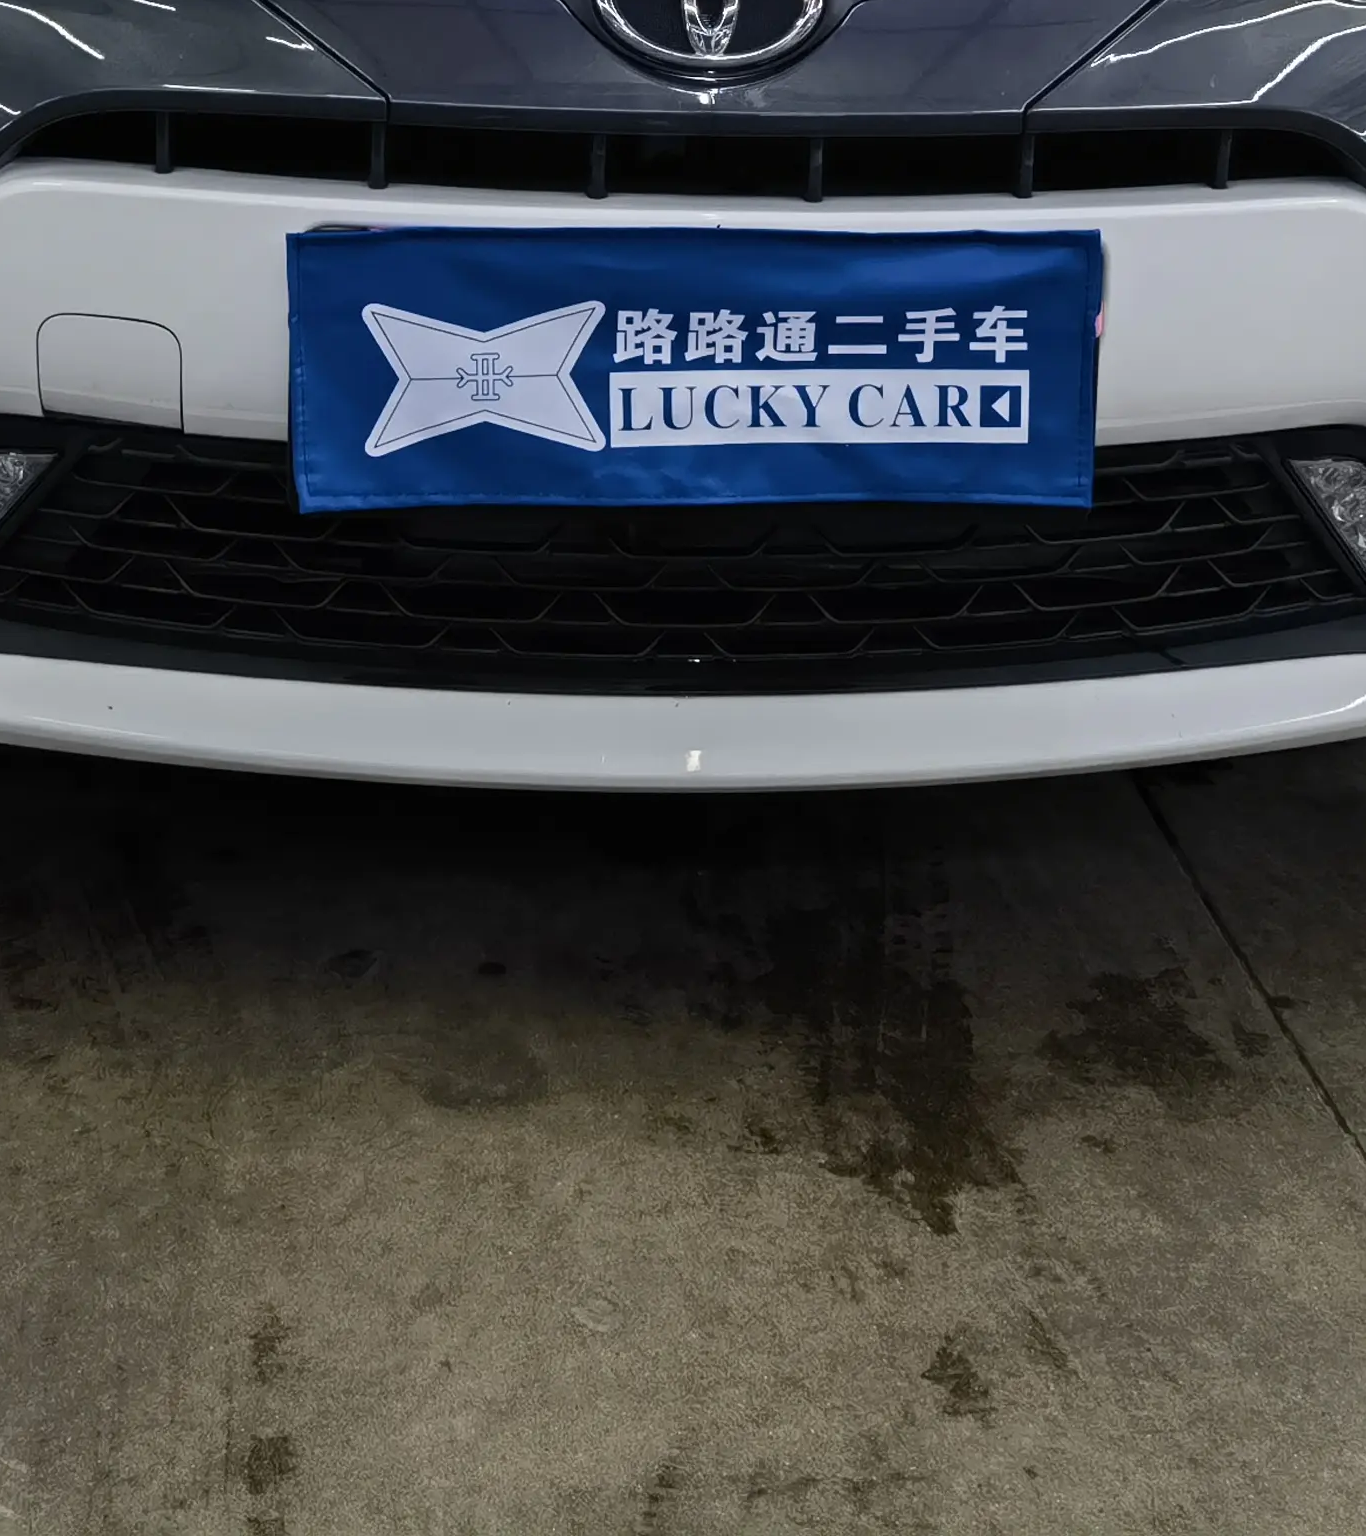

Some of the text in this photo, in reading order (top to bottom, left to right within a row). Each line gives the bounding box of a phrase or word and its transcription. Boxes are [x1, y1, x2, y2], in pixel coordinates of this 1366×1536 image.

[613, 306, 1028, 364] 路路通二手车
[617, 382, 973, 432] LUCKY CAR
